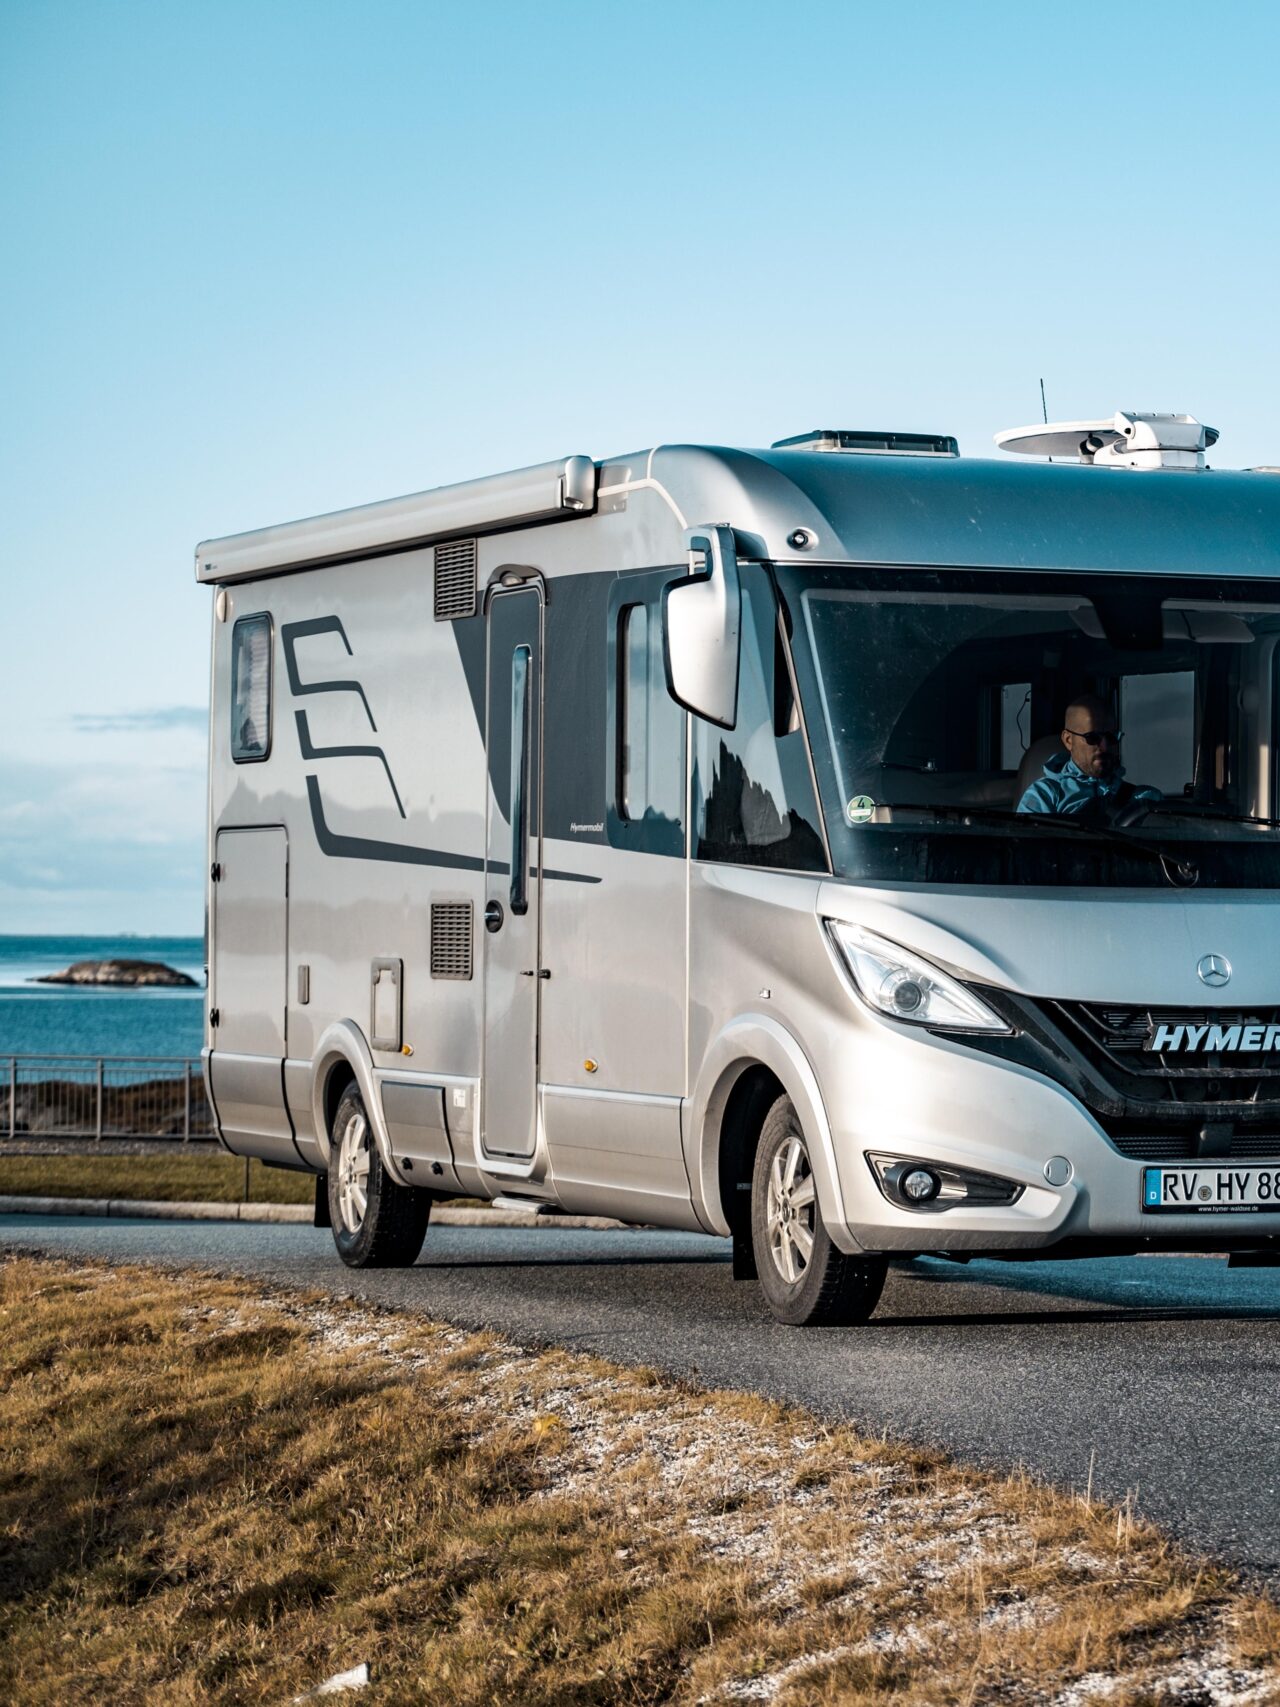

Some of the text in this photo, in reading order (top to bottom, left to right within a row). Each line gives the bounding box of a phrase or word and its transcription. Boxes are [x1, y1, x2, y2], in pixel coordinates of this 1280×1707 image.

[857, 797, 865, 809] 4
[570, 822, 604, 833] Hymermobil
[1163, 1173, 1198, 1201] RV
[1216, 1172, 1250, 1200] HY
[1150, 1191, 1157, 1199] D
